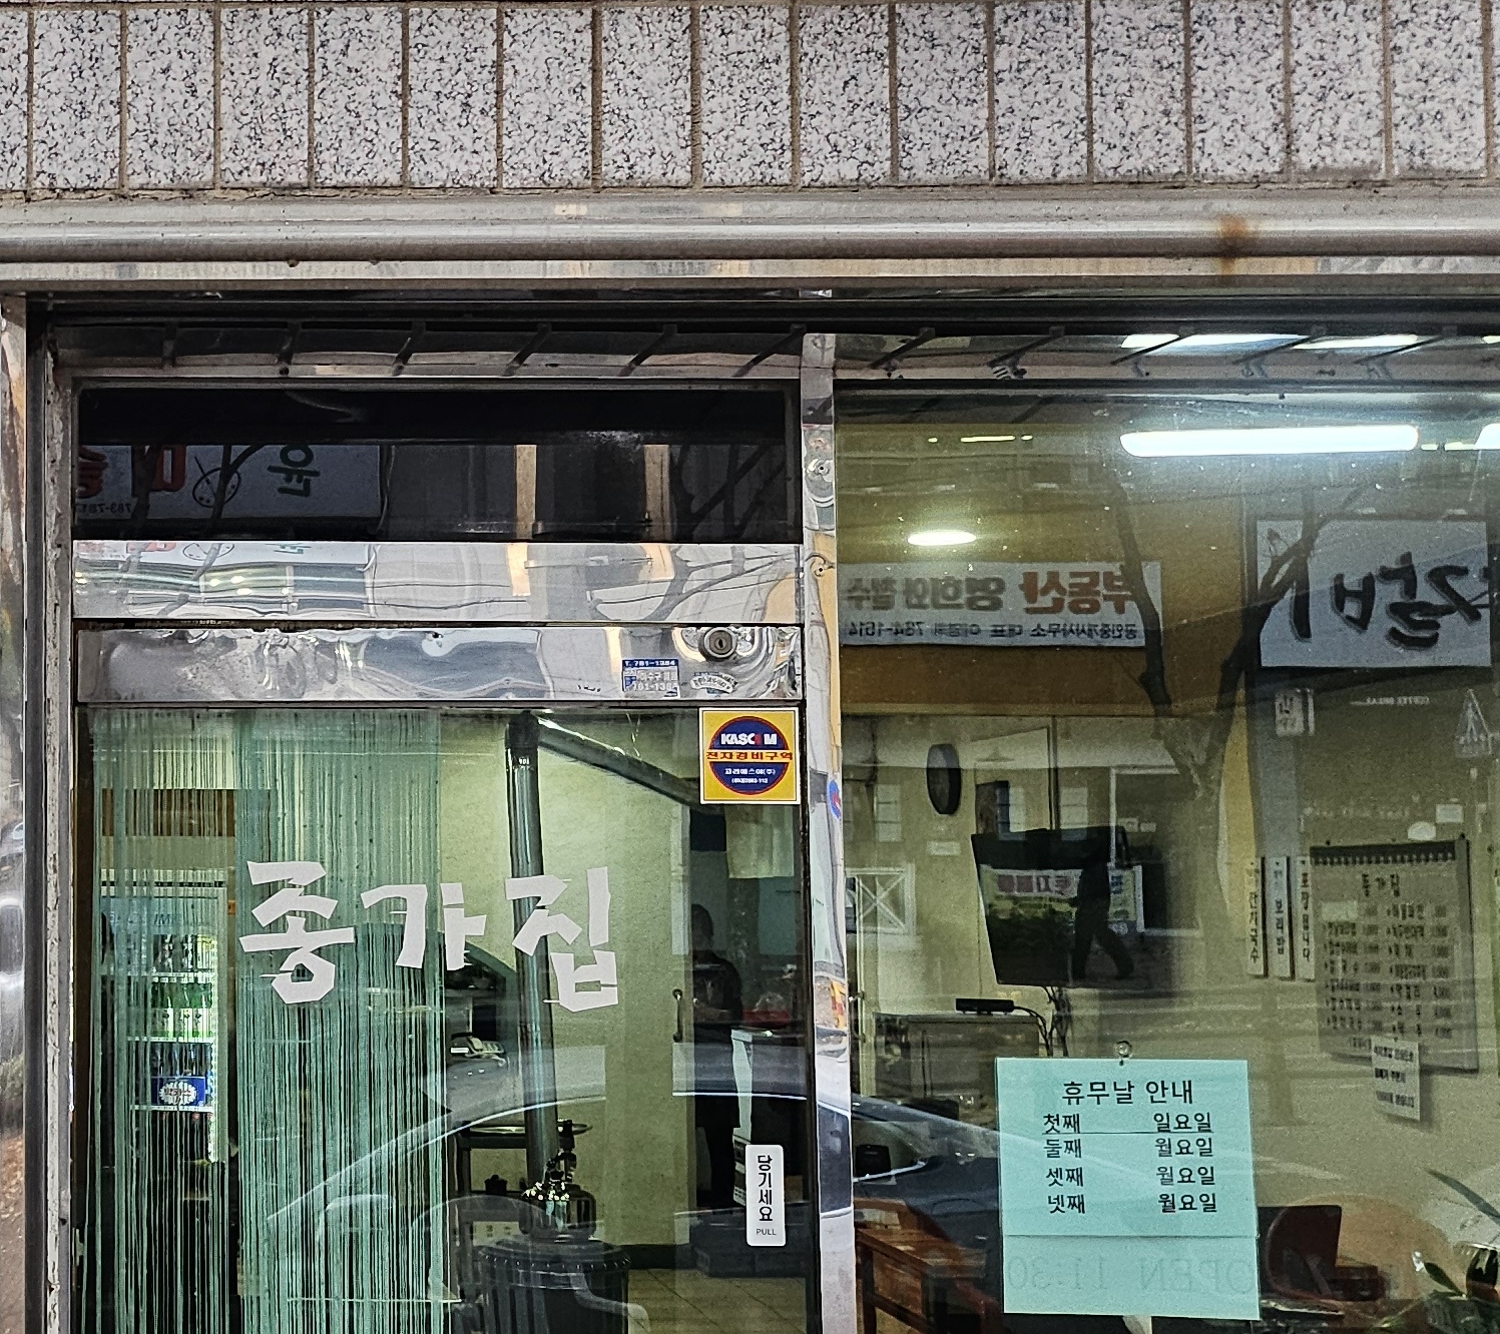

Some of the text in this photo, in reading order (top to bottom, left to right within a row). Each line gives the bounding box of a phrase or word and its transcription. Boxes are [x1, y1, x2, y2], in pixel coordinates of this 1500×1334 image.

[706, 751, 794, 761] 전자경비구역
[239, 861, 619, 1013] 종가집
[1061, 1080, 1194, 1105] 휴무날 안내
[1042, 1112, 1213, 1134] 첫째 일요일
[1043, 1137, 1214, 1158] 둘째 월요일
[1045, 1165, 1216, 1187] 셋째 월요일
[756, 1154, 774, 1222] 당기세요
[1046, 1192, 1218, 1214] 넷째 월요일
[755, 1228, 777, 1236] PULL
